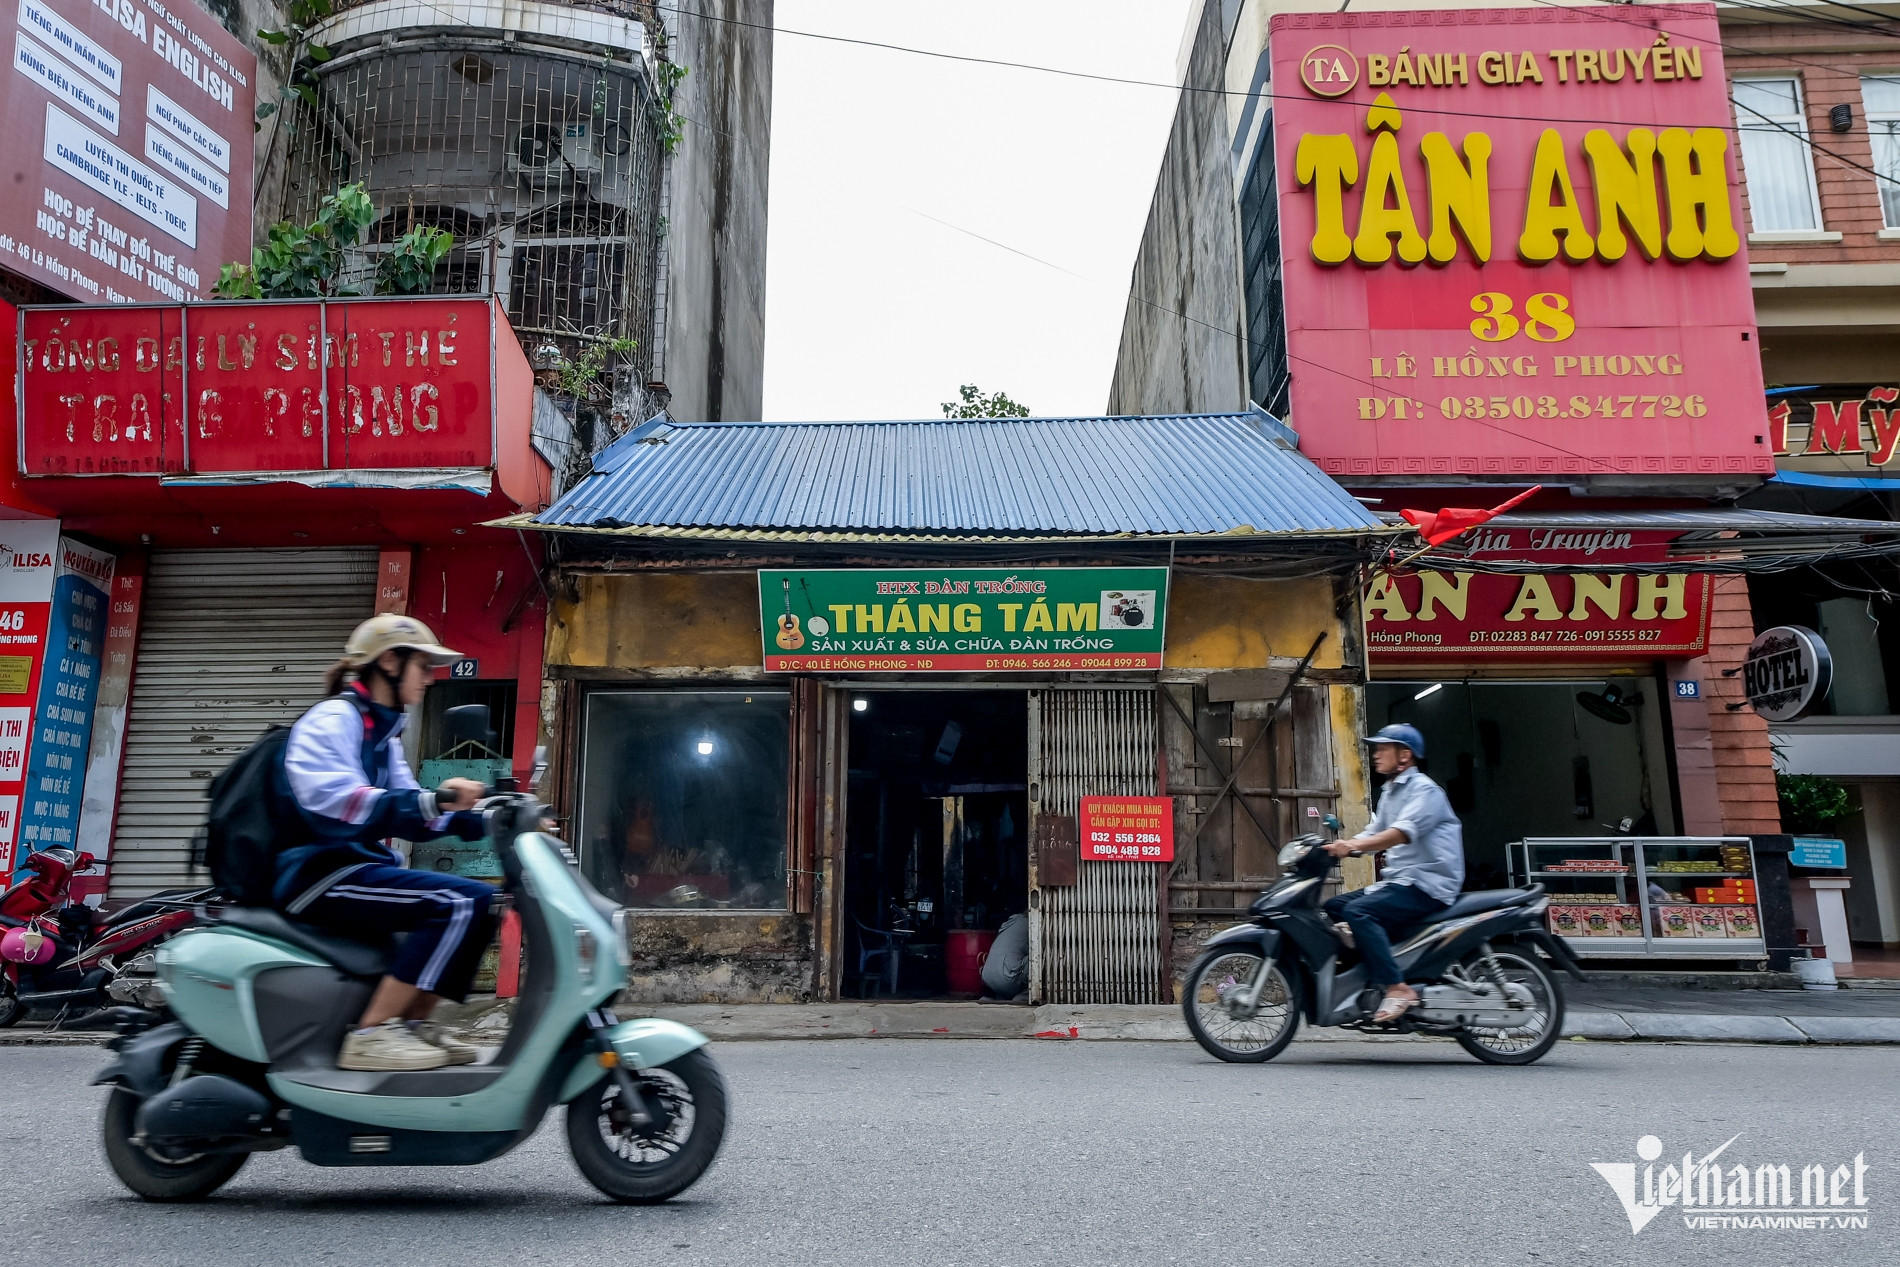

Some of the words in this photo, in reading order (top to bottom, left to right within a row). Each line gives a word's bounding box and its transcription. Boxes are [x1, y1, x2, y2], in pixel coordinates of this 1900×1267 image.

[26, 5, 52, 34] TIẾNG
[54, 27, 72, 48] ANH
[97, 59, 116, 80] NON
[153, 24, 234, 112] ENGLISH
[213, 52, 228, 72] CAO
[1307, 57, 1351, 83] TA
[1367, 45, 1469, 88] BÁNH
[1477, 50, 1544, 86] GIA
[1549, 32, 1703, 83] TRUYỀN
[47, 68, 69, 92] BIỆN
[70, 84, 96, 110] TIẾNG
[96, 103, 114, 123] ANH
[172, 116, 192, 136] PHÁP
[85, 139, 114, 168] LUYỆN
[115, 158, 130, 178] THI
[130, 168, 154, 193] QUỐC
[154, 184, 166, 200] TẾ
[151, 140, 173, 163] TIẾNG
[174, 158, 190, 175] ANH
[190, 168, 208, 188] GIAO
[208, 178, 223, 196] TIẾP
[1295, 91, 1492, 266] TÂN
[1517, 127, 1740, 264] ANH
[56, 143, 111, 186] CAMBRIDGE
[112, 178, 128, 197] YLE
[135, 192, 158, 215] IELTS
[164, 210, 188, 233] TOEIC
[36, 209, 66, 242] HỌC
[44, 187, 73, 220] HỌC
[96, 216, 128, 250] THAY
[176, 266, 200, 290] GIỚI
[17, 242, 30, 260] 46
[32, 248, 44, 266] Lê
[45, 255, 70, 282] Hồng
[70, 266, 99, 296] Phong
[1468, 292, 1576, 342] 38
[1368, 350, 1418, 380] LÊ
[1432, 346, 1540, 379] HỒNG
[1552, 353, 1685, 378] PHONG
[1356, 396, 1425, 420] ĐT:
[1440, 394, 1708, 419] 03503.847726
[13, 553, 52, 567] ILISA
[876, 581, 921, 595] HTX
[924, 578, 971, 595] ĐÀN
[974, 575, 1047, 594] TRỐNG
[1503, 574, 1688, 622] ANH
[0, 610, 24, 630] 46
[828, 597, 982, 634] THÁNG
[998, 596, 1098, 632] TÁM
[12, 635, 38, 644] PHONG
[811, 637, 846, 652] SẢN
[852, 636, 895, 651] XUẤT
[900, 640, 912, 651] &
[916, 636, 950, 651] SỬA
[954, 636, 1004, 650] CHỮA
[1009, 636, 1048, 650] ĐÀN
[1053, 634, 1114, 650] TRỐNG
[1371, 629, 1402, 645] Hồng
[1404, 632, 1442, 645] Phong
[1470, 630, 1489, 642] ĐT:
[1490, 630, 1527, 642] 02283
[1530, 630, 1551, 642] 847
[1638, 630, 1662, 640] 827
[456, 661, 474, 676] 42
[779, 660, 804, 670] Đ/C:
[805, 660, 818, 670] 40
[820, 658, 831, 670] LÊ
[833, 656, 865, 670] HỒNG
[868, 660, 907, 670] PHONG
[917, 660, 933, 669] NĐ
[986, 660, 1000, 668] ĐT:
[1032, 659, 1050, 668] 566
[1053, 659, 1072, 668] 246
[1081, 658, 1112, 668] 09044
[1114, 658, 1132, 668] 899
[1134, 658, 1147, 668] 28
[1744, 648, 1809, 698] HOTEL
[1679, 682, 1695, 695] 38
[6, 720, 22, 738] THI
[1102, 802, 1125, 815] KHÁCH
[1126, 804, 1142, 815] MUA
[1144, 803, 1162, 815] HÀNG
[1122, 818, 1134, 828] XIN
[1136, 818, 1148, 830] GỌI
[1091, 832, 1110, 842] 032
[1115, 833, 1134, 843] 556
[1136, 834, 1162, 844] 2864
[1094, 844, 1118, 855] 0904
[1120, 846, 1140, 856] 489
[1142, 846, 1161, 856] 928
